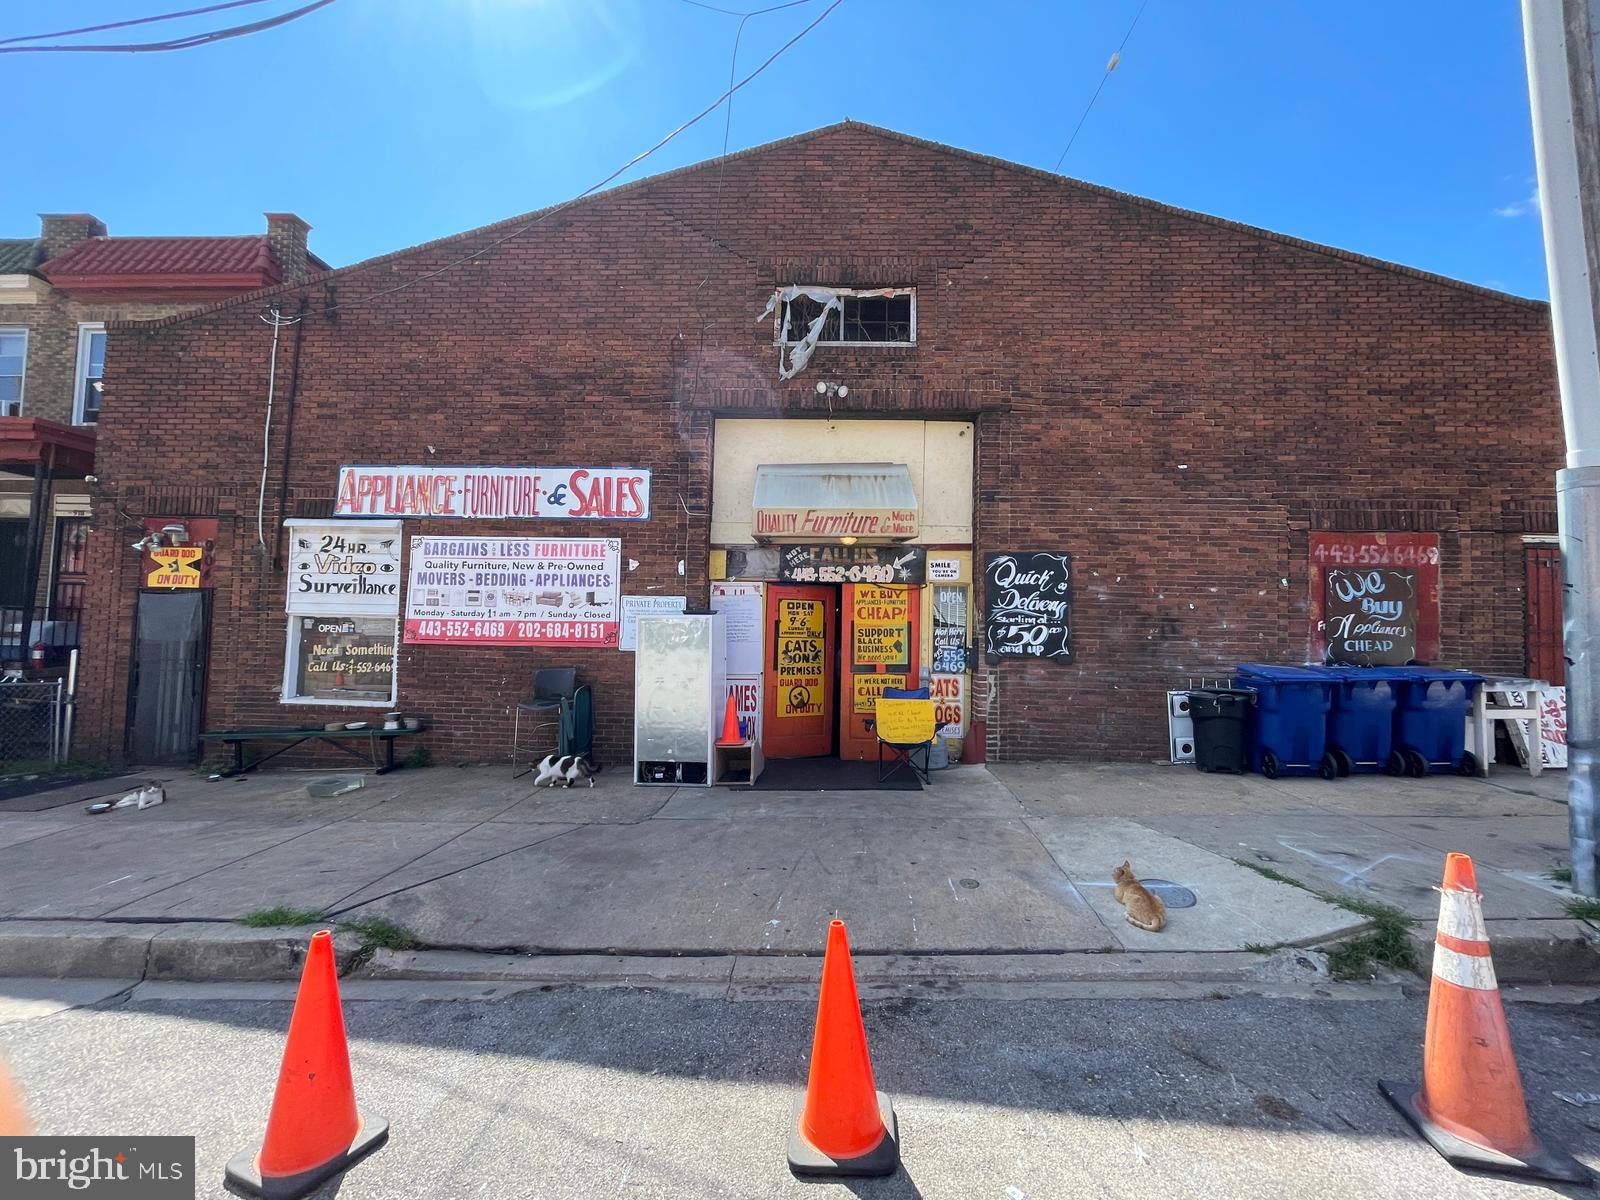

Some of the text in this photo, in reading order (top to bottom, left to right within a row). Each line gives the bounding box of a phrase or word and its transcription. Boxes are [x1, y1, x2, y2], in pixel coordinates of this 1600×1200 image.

[335, 469, 644, 518] APPLIANCE FURNITURE & SALES
[757, 510, 798, 533] QUALITY
[801, 510, 879, 535] Furniture
[424, 543, 488, 557] BARGAINS
[500, 543, 530, 557] LESS
[534, 543, 606, 558] FURNITURE
[785, 546, 802, 560] NOT
[809, 547, 879, 564] CALL US
[314, 554, 377, 574] Video
[789, 551, 810, 567] HERE
[424, 561, 604, 572] Quality Furniture, New & Pre-Owned
[157, 575, 198, 585] ON DUTY
[417, 572, 466, 586] MOVERS
[995, 561, 1055, 591] Quick
[298, 573, 397, 595] Surveillance
[1335, 571, 1385, 602] We
[860, 590, 904, 599] WE BUY
[940, 591, 963, 602] OPEN
[625, 599, 682, 608] PRIVATE PROPERTY
[787, 602, 814, 610] OPEN
[992, 588, 1068, 620] Delivery
[1360, 597, 1403, 620] Buy
[414, 609, 445, 619] Monday
[451, 609, 485, 619] Saturday
[548, 611, 577, 620] Sunday
[584, 611, 611, 619] Closed
[857, 606, 906, 620] CHEAP!
[318, 624, 342, 632] OPEN
[419, 621, 505, 638] 443-552-6469
[518, 623, 605, 639] 202-684-8151
[1330, 613, 1407, 638] Appliances
[858, 628, 904, 637] SUPPORT
[785, 640, 818, 653] CATS
[935, 637, 949, 646] Call
[1344, 640, 1393, 652] CHEAP
[312, 642, 393, 656] Need Somethin
[858, 645, 893, 653] BUSINESS
[998, 645, 1044, 656] and up
[793, 653, 810, 663] ON
[307, 661, 328, 672] Call
[781, 666, 822, 676] PREMISES
[933, 661, 966, 672] 6469
[858, 686, 882, 696] CALL
[726, 684, 757, 712] AMES
[935, 705, 961, 724] OGS
